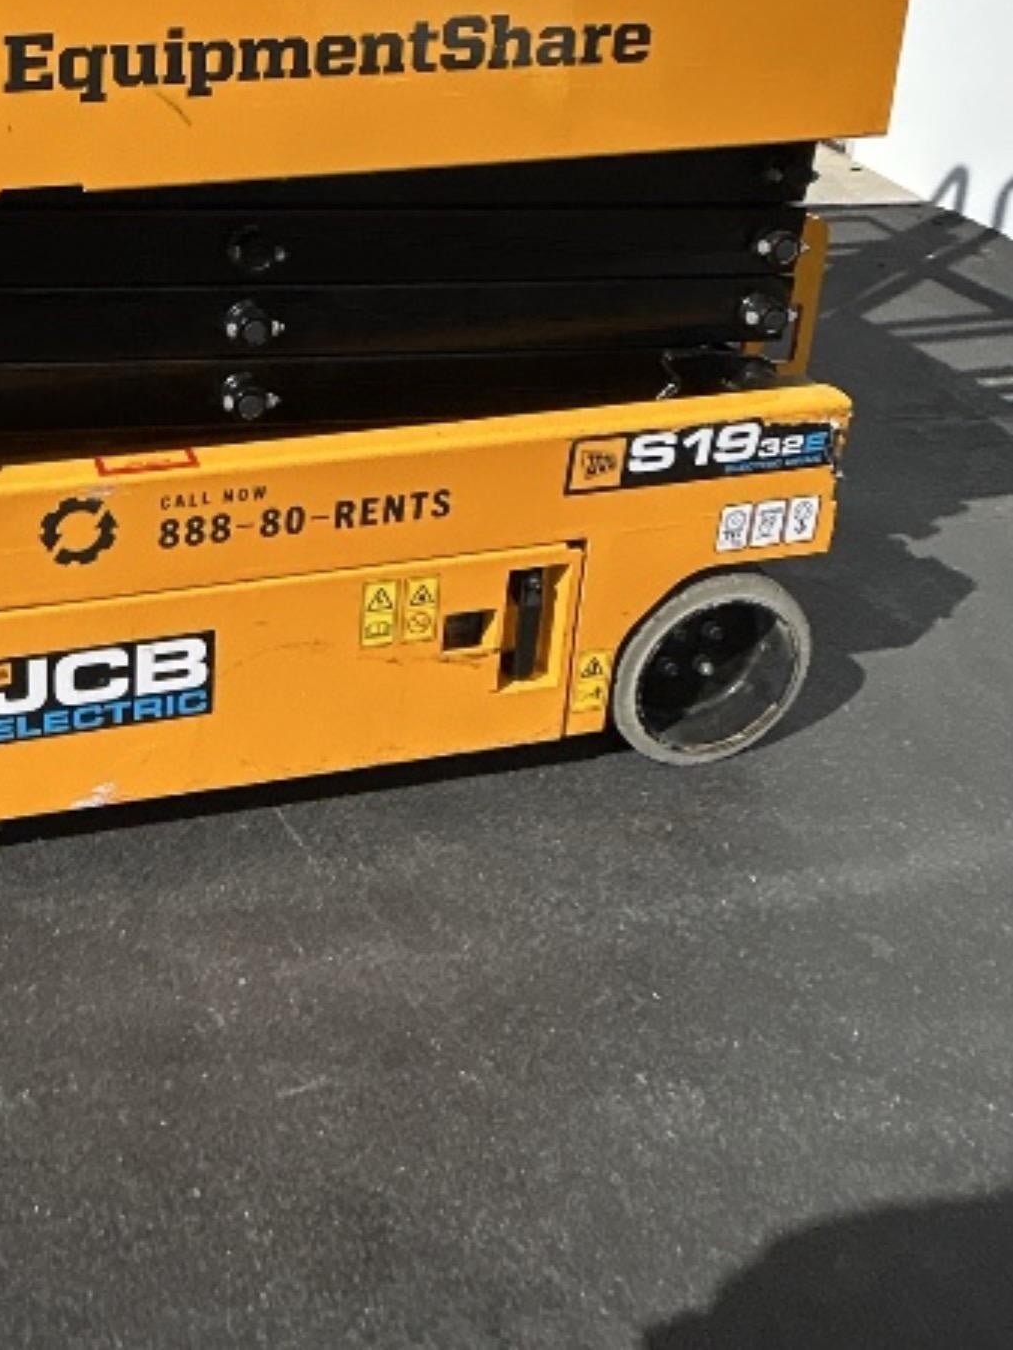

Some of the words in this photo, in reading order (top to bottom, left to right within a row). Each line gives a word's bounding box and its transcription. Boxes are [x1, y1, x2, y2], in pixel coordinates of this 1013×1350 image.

[2, 14, 653, 103] EquipmentShare
[158, 489, 452, 550] 888-80-RENTS
[160, 491, 211, 510] CALL
[223, 484, 268, 501] NOW
